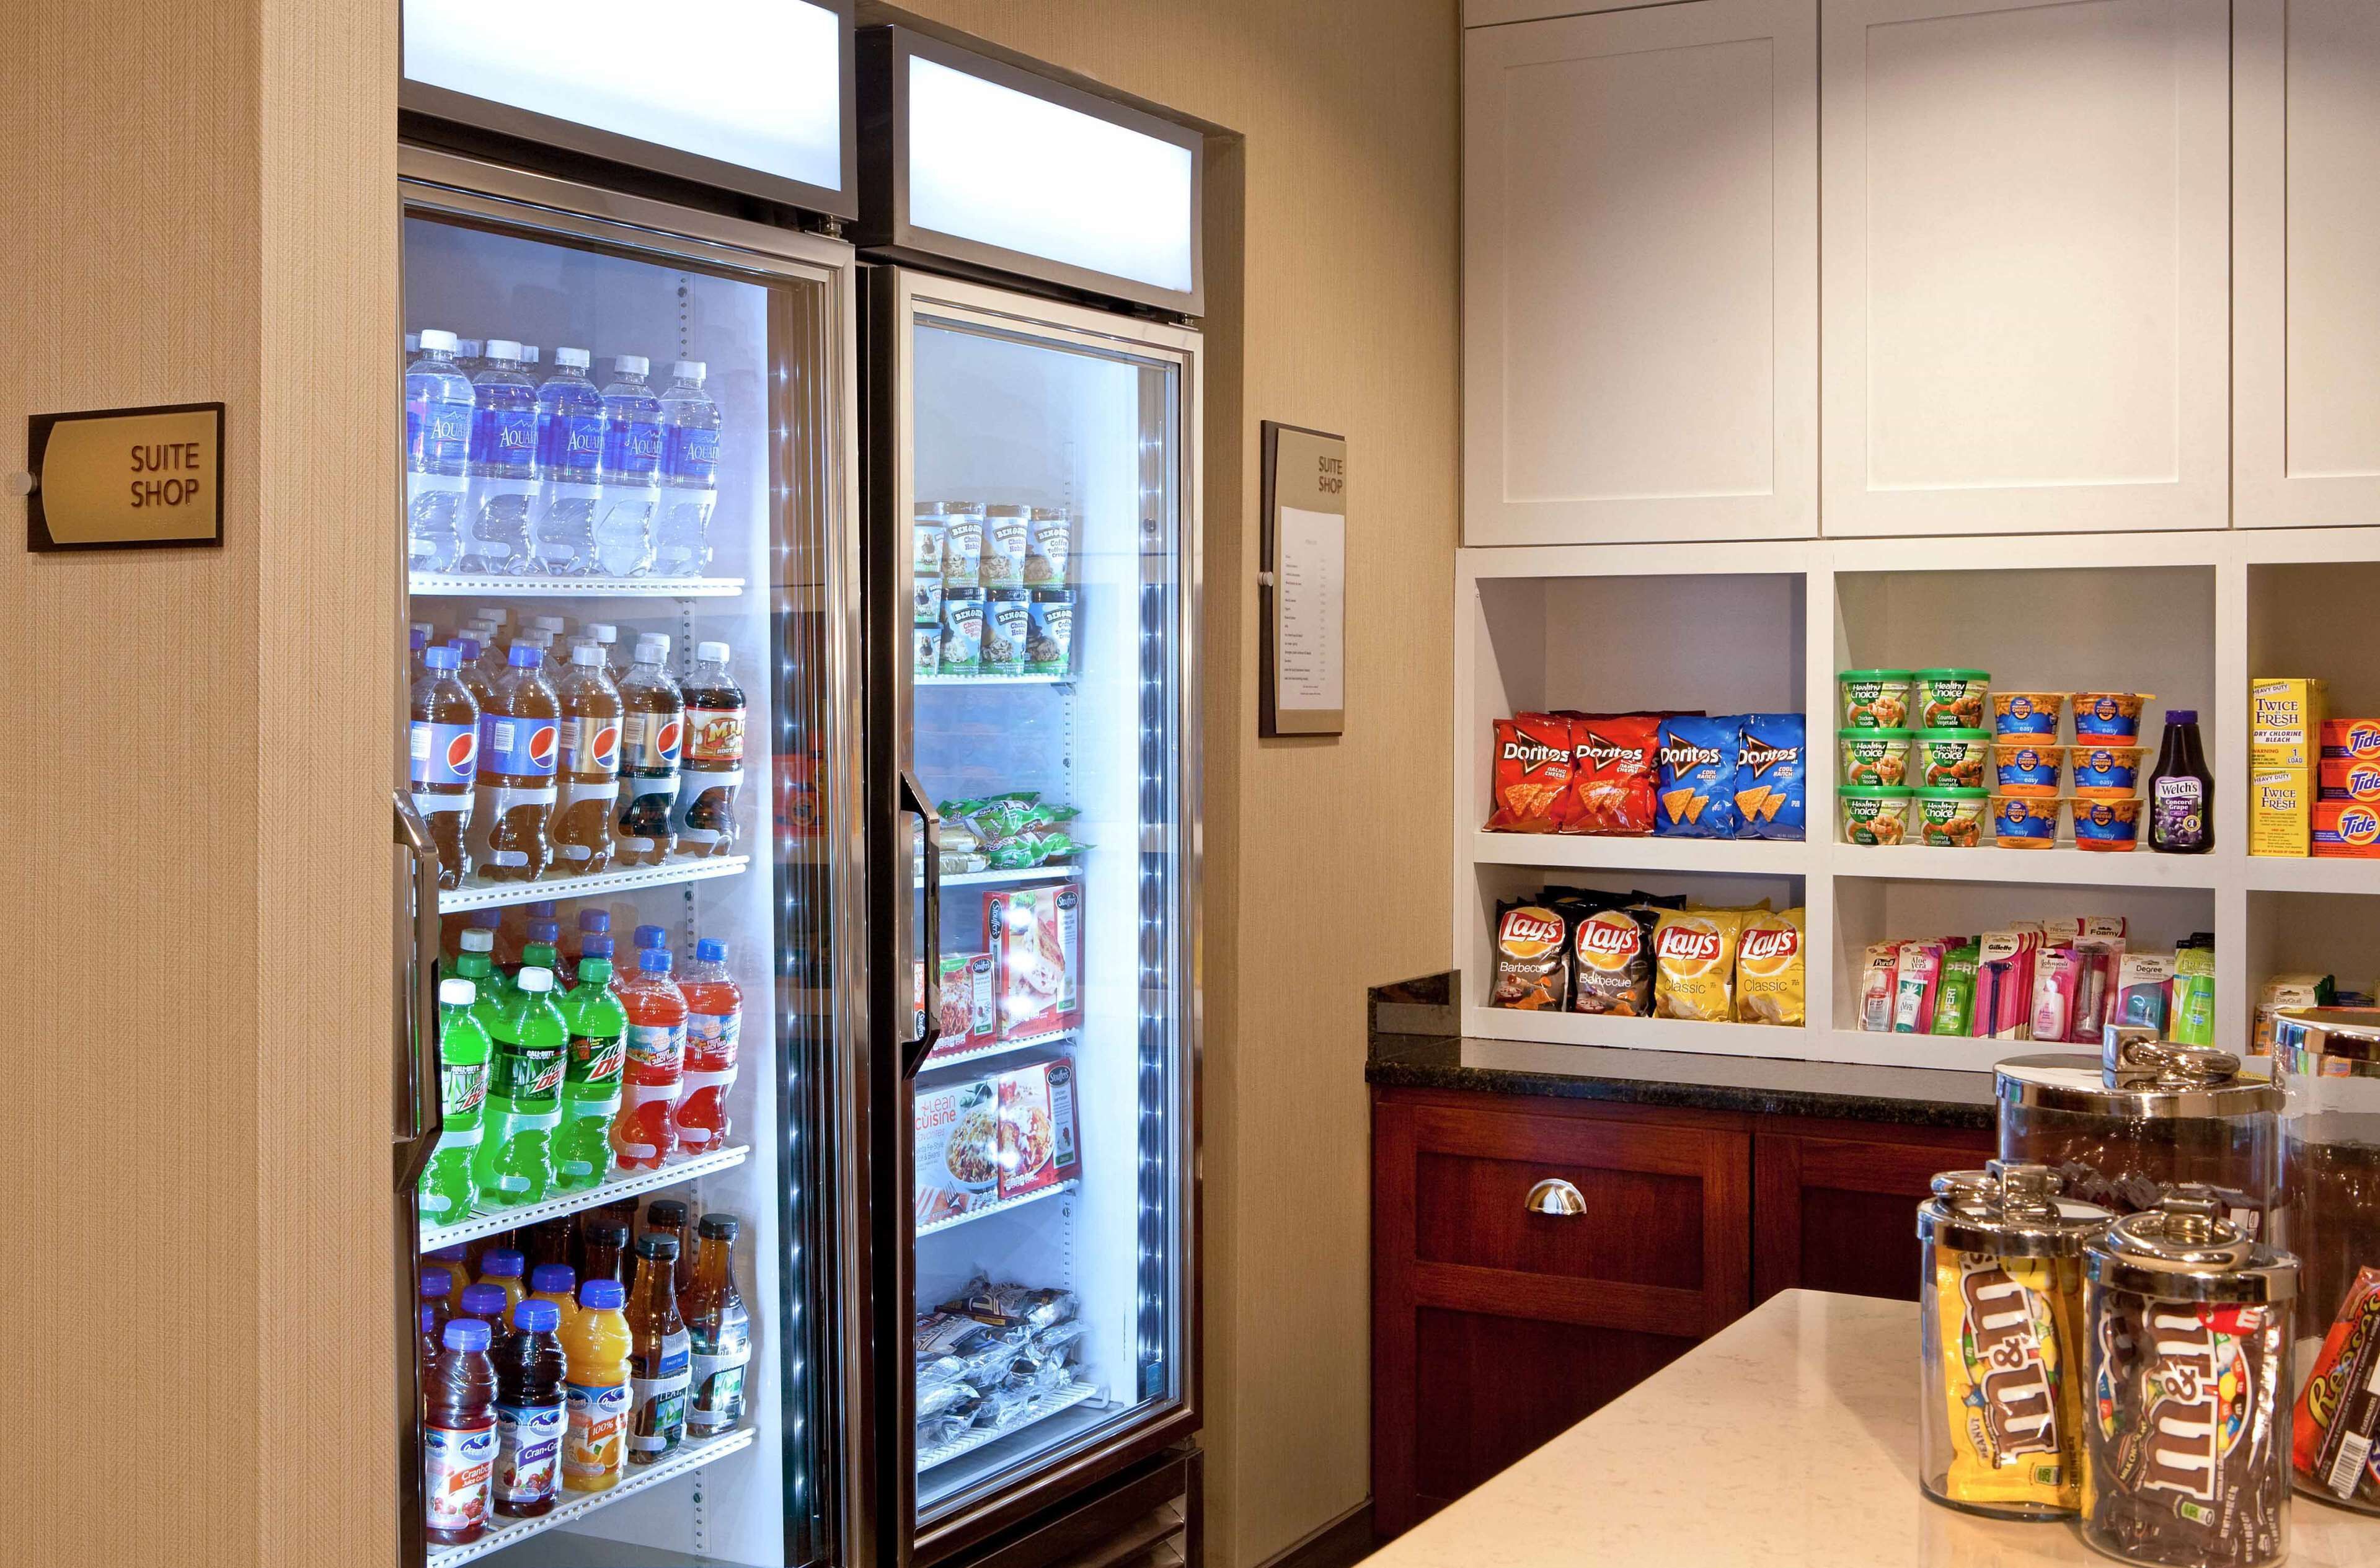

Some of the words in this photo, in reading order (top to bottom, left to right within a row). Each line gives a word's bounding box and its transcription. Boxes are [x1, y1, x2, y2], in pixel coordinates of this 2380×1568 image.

[131, 443, 200, 472] SUITE
[1319, 456, 1343, 475] SUITE
[131, 478, 200, 508] SHOP
[1319, 477, 1342, 493] SHOP
[1852, 681, 1881, 690] Healthy
[1931, 689, 1963, 697] Choice
[1935, 680, 1965, 690] Healthy
[1851, 689, 1879, 698] Choice
[2255, 698, 2298, 711] TWICE
[2256, 711, 2298, 727] FRESH
[2102, 728, 2118, 736] easy
[1856, 742, 1886, 750] Healthy
[1935, 744, 1965, 753] Healthy
[2350, 729, 2380, 752] Tide
[1503, 742, 1571, 762] Doritos
[1576, 744, 1643, 760] Doritos
[1660, 747, 1721, 765] Doritos
[1736, 747, 1798, 765] Doritos
[1854, 748, 1883, 757] Choice
[1932, 749, 1963, 760] Choice
[2293, 748, 2297, 757] 1
[2161, 782, 2198, 795] Welch's
[2350, 772, 2380, 795] Tide
[2262, 786, 2296, 798] TWICE
[1849, 806, 1878, 816] Choice
[2262, 798, 2296, 811] FRESH
[1924, 809, 1953, 817] Choice
[2342, 815, 2377, 837] Tide
[1502, 912, 1561, 943] Lay's
[2090, 929, 2119, 937] Foamy
[1580, 921, 1636, 954] Lay's
[1658, 928, 1718, 961] Lay's
[1740, 930, 1795, 961] Lay's
[1500, 962, 1549, 974] Barbecue
[1945, 961, 1980, 976] PERT
[2041, 959, 2068, 967] Johnson's
[2136, 965, 2163, 974] Degree
[1579, 972, 1632, 988] Barbecue
[1664, 978, 1705, 995] Classic
[1744, 979, 1787, 992] Classic
[1050, 1069, 1069, 1083] Stouffer's
[929, 1095, 956, 1113] Lean
[915, 1111, 956, 1130] cuisine
[2308, 1294, 2380, 1427] Reese's
[593, 1419, 614, 1436] 100%
[1971, 1417, 1989, 1459] PEANUT
[2120, 1463, 2133, 1481] MILK
